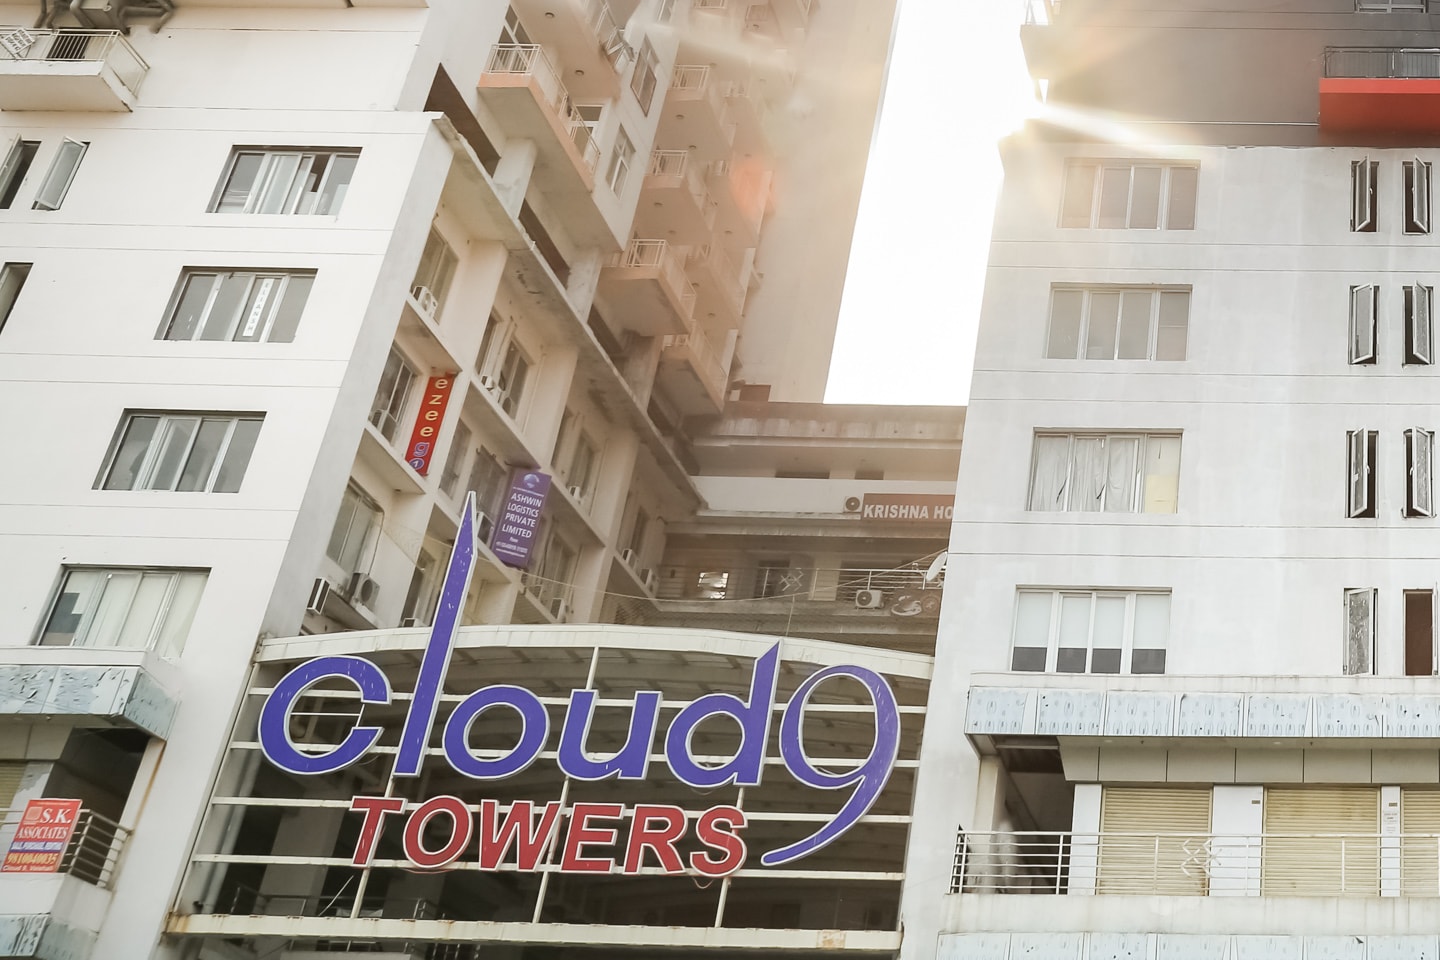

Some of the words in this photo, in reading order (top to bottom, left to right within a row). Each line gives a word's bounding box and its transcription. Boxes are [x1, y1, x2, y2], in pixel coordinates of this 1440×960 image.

[510, 492, 543, 508] ASHWIN
[506, 502, 540, 518] LOGISTICS
[863, 504, 929, 519] KRISHNA
[504, 512, 537, 528] PRIVATE
[501, 524, 533, 539] LIMITED
[40, 807, 72, 824] S.K.
[16, 826, 69, 839] ASSOCIATES
[349, 794, 748, 878] TOWERS
